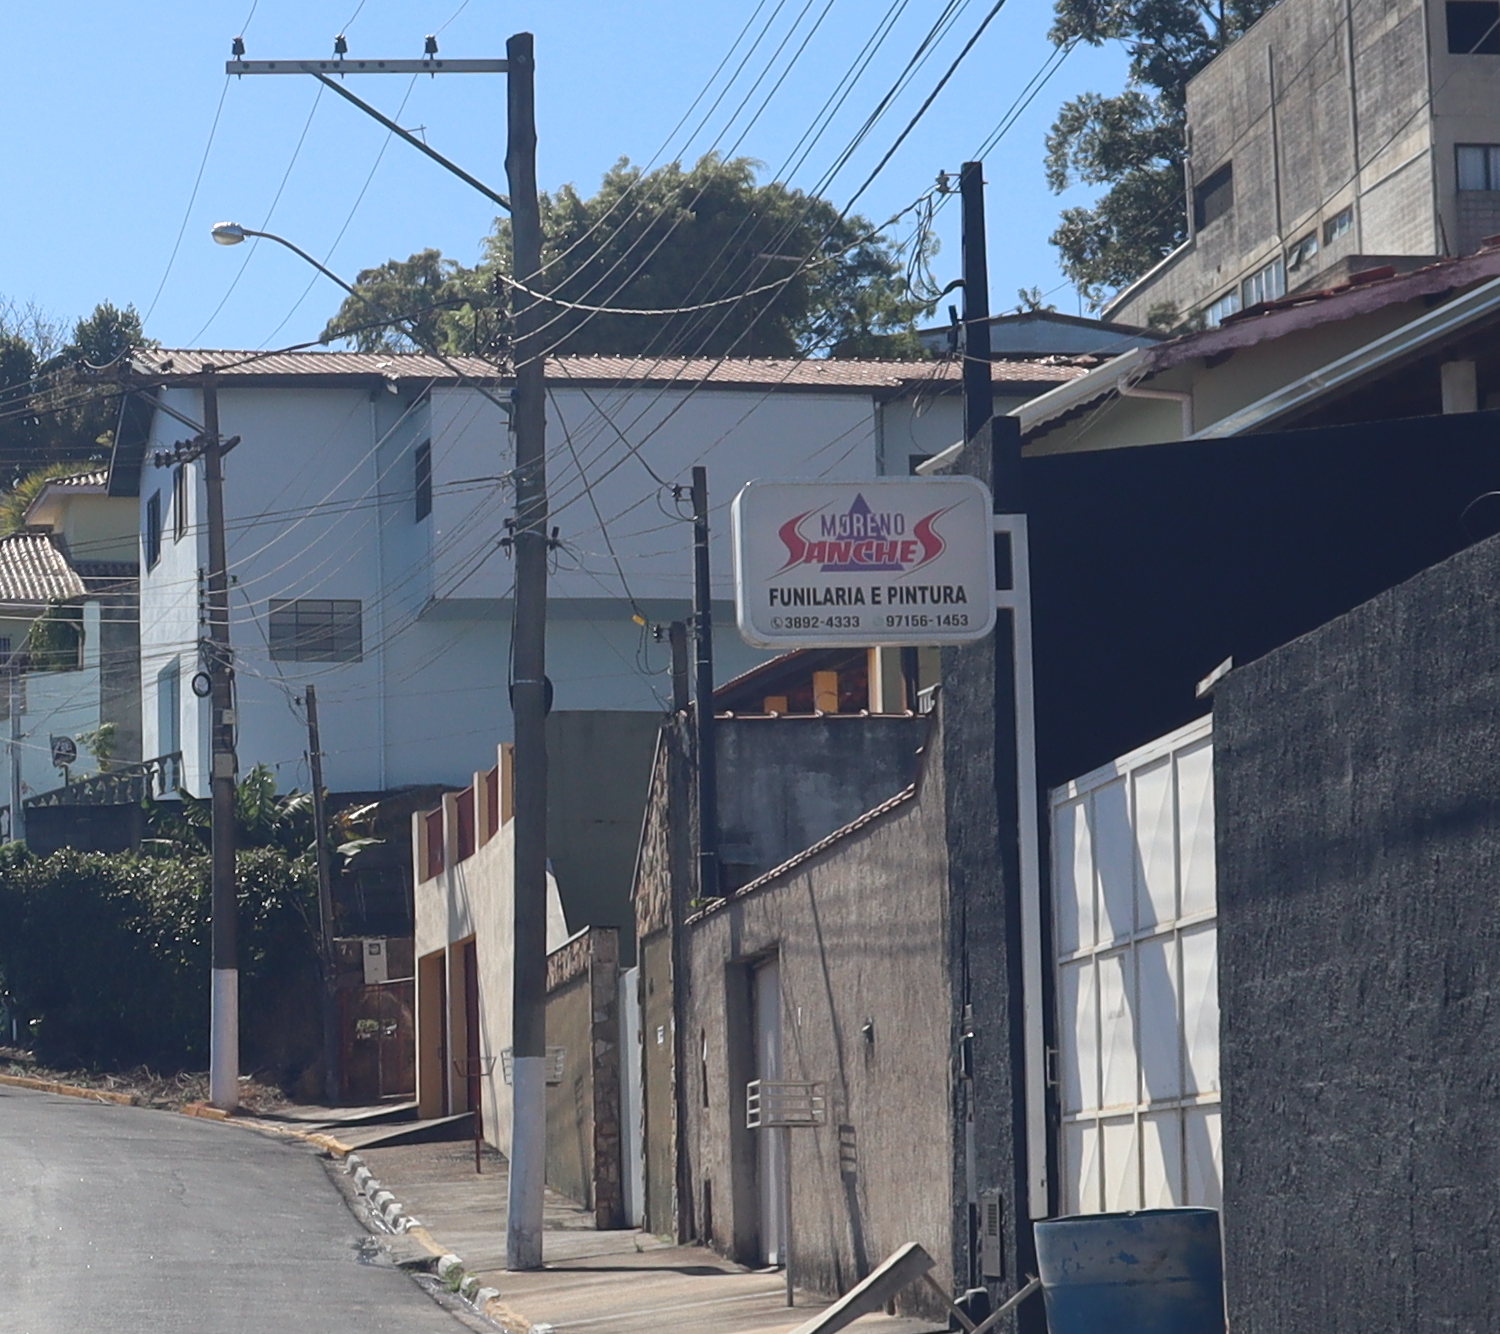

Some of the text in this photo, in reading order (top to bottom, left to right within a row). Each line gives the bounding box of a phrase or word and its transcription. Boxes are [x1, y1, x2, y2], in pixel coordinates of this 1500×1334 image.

[821, 513, 904, 536] MORENO
[777, 506, 946, 572] SANCHES
[769, 586, 968, 606] FUNILARIA E PINTURA
[785, 615, 970, 629] 3892-4333 97156-1453
